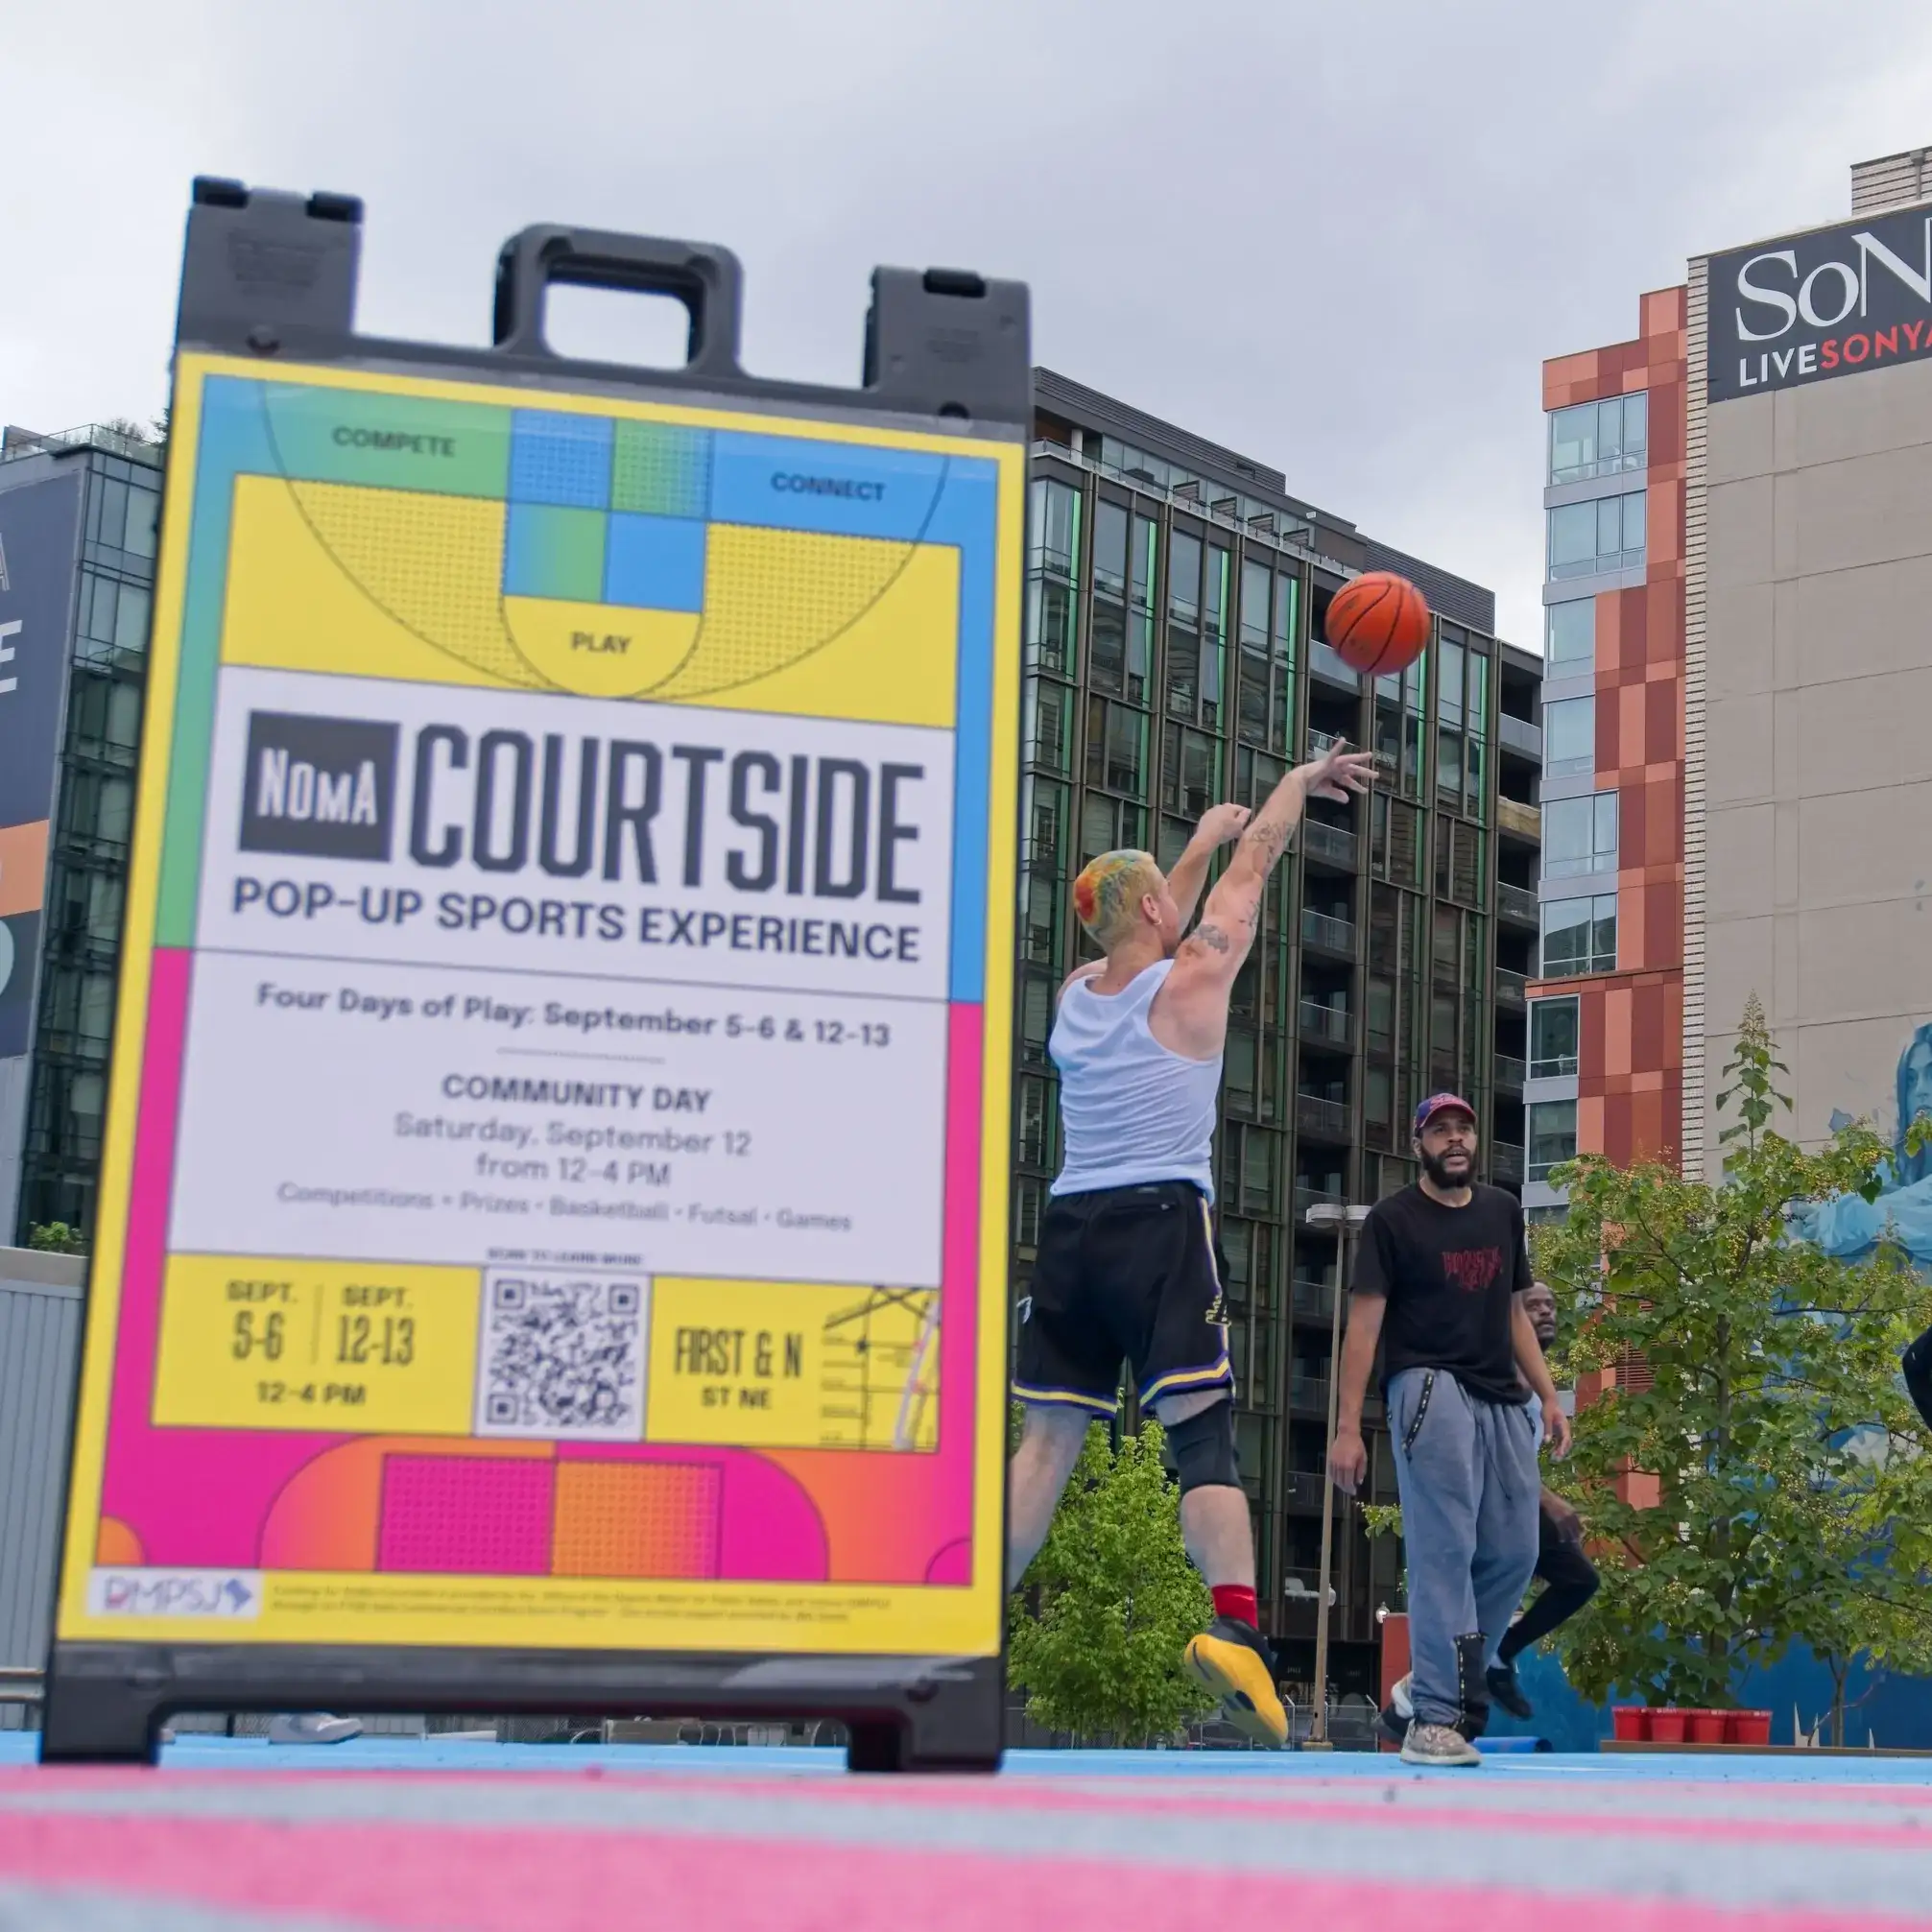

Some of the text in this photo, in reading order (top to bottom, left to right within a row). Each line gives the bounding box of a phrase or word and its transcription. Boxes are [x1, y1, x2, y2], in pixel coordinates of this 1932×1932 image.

[331, 426, 456, 458] COMPETE
[770, 471, 885, 501] CONNECT
[570, 631, 632, 655] PLAY
[409, 723, 924, 905] COURTSIDE
[233, 876, 920, 962] POP-UP SPORTS EXPERIENCE
[256, 982, 329, 1010] Four
[339, 988, 413, 1021] Days
[421, 994, 455, 1018] of
[544, 1002, 718, 1035] September
[725, 1014, 775, 1040] 5-6
[783, 1018, 804, 1042] &
[814, 1020, 891, 1048] 12-13
[441, 1074, 712, 1112] COMMUNITY DAY
[545, 1121, 714, 1152] September
[723, 1131, 751, 1156] 12
[477, 1153, 671, 1187] from 12-4 PM
[277, 1181, 852, 1232] Competitions Prizes Basketball Futsal Games
[232, 1310, 284, 1361] 5-6
[337, 1314, 416, 1366] 12-13
[675, 1325, 802, 1378] FIRST & N
[323, 1383, 367, 1406] PM
[702, 1385, 772, 1410] ST NE
